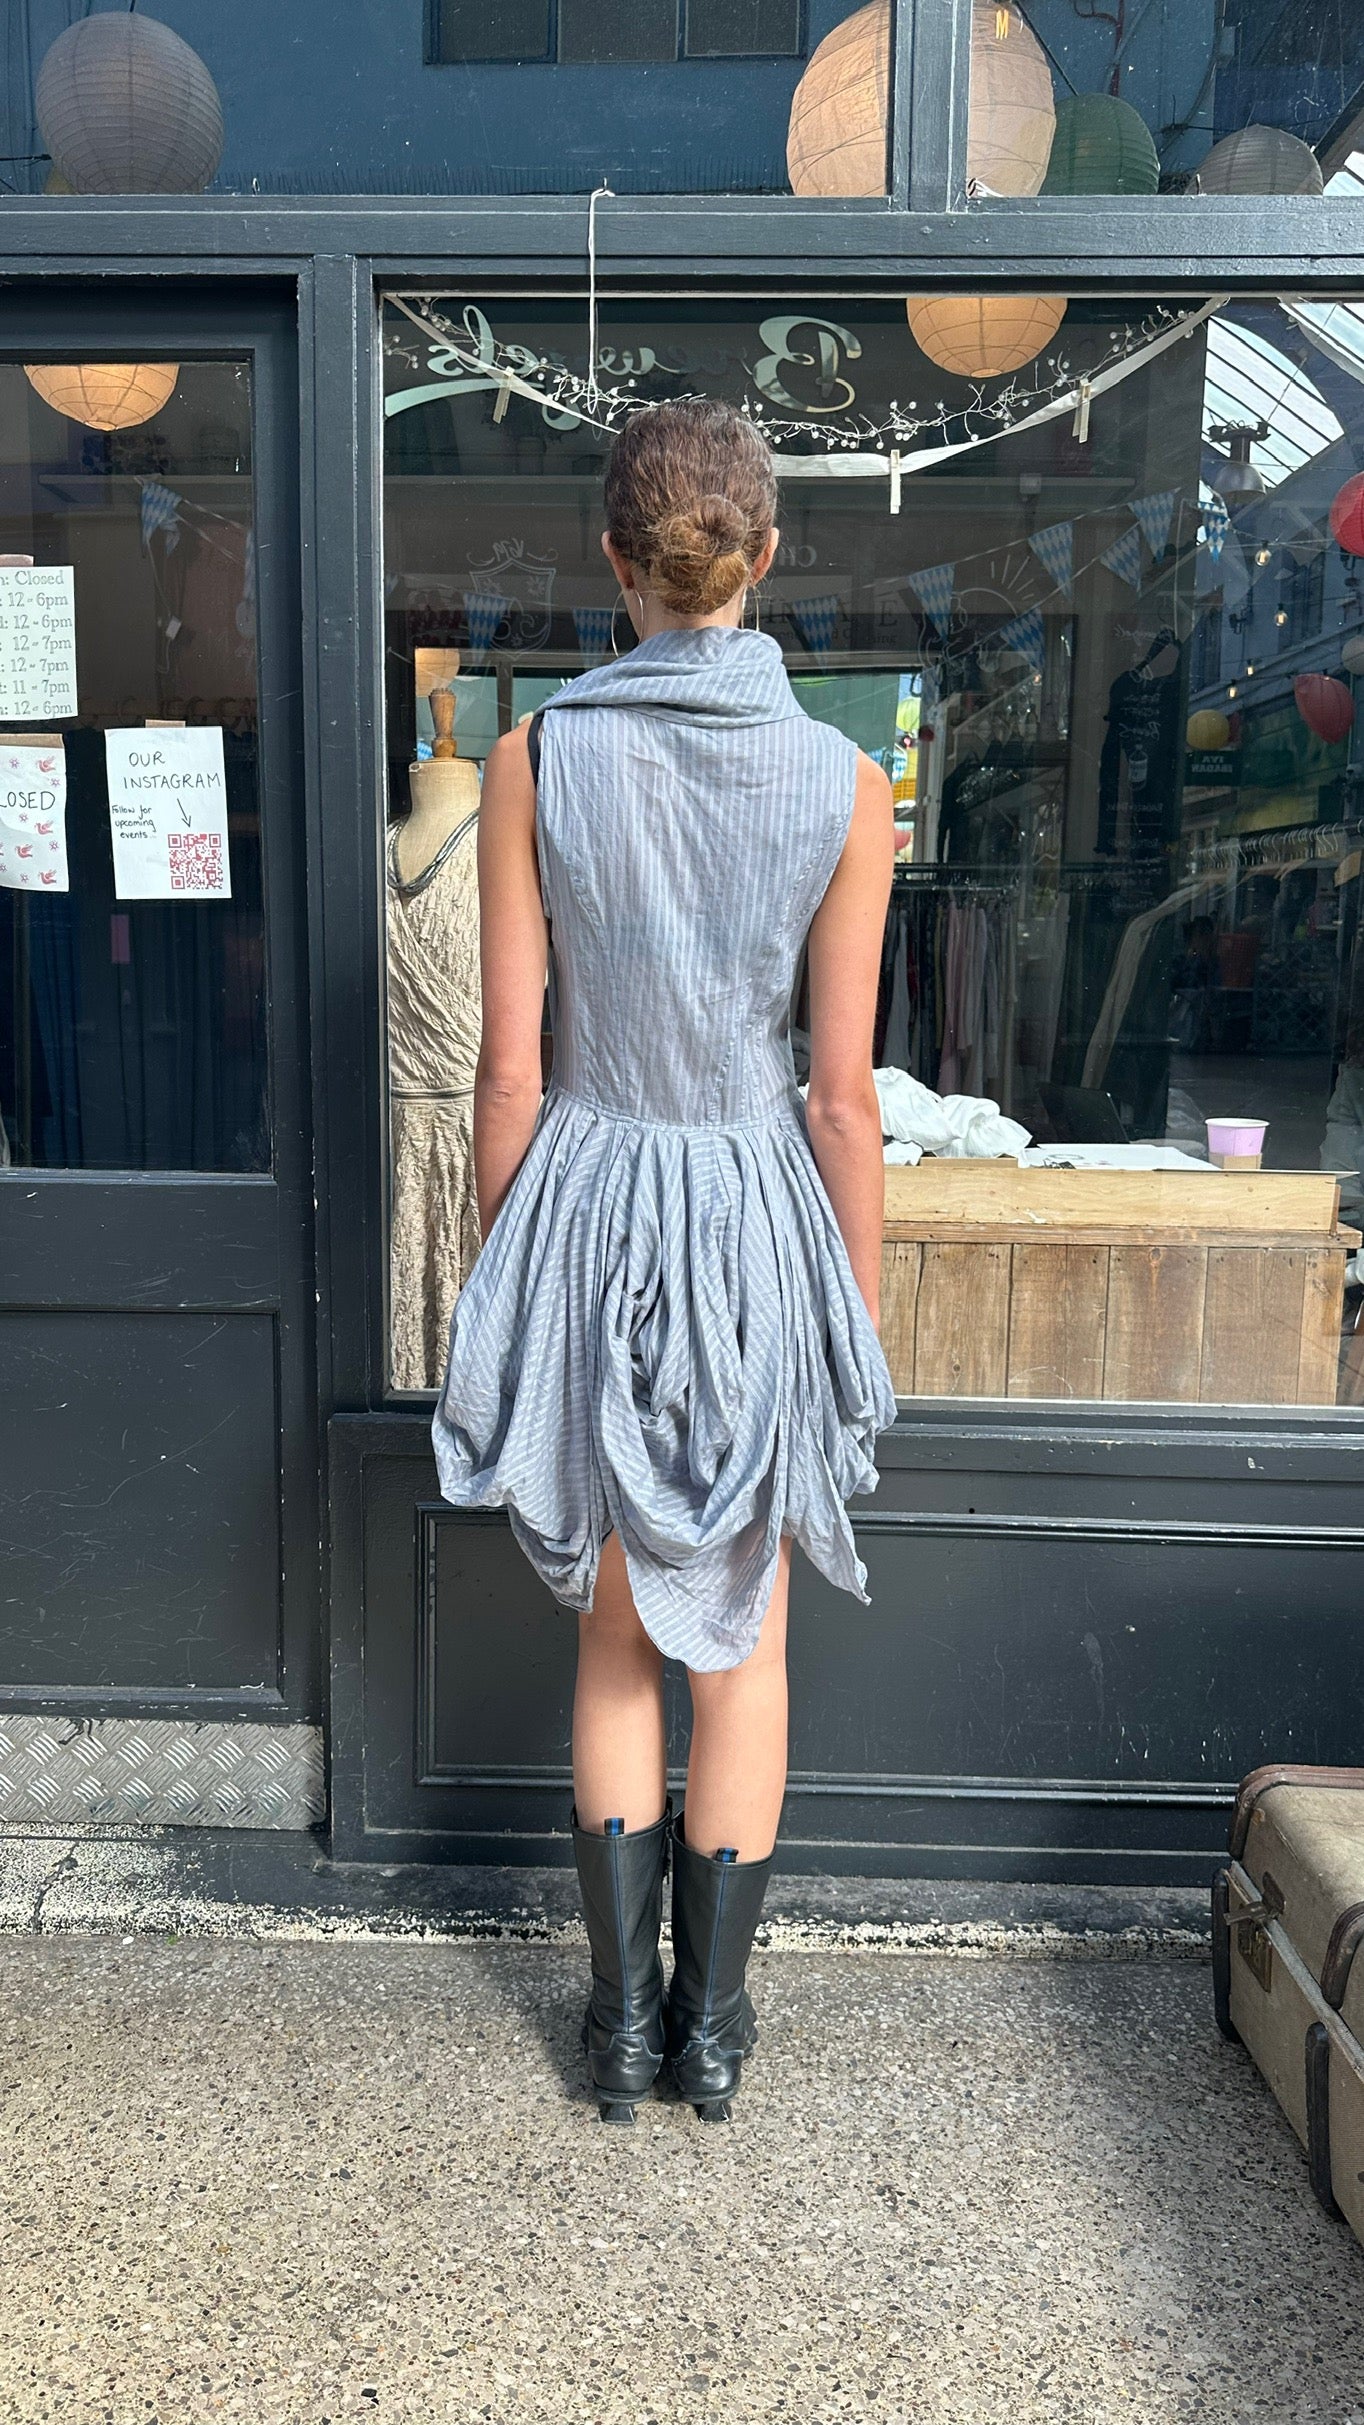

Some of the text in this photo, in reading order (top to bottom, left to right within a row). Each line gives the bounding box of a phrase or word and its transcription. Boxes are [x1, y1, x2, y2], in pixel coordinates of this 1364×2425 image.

[14, 570, 65, 585] Closed
[8, 592, 25, 607] 12
[36, 592, 69, 610] 6pm
[13, 614, 30, 629] 12
[41, 614, 73, 632] 6pm
[13, 635, 30, 651] 12
[42, 635, 72, 654] 7pm
[10, 657, 27, 672] 12
[39, 658, 69, 675] 7pm
[13, 680, 27, 694] 11
[42, 679, 70, 697] 7pm
[14, 700, 31, 715] 12
[43, 701, 73, 718] 6pm
[128, 751, 166, 767] OUR
[123, 772, 221, 789] INSTAGRAM
[0, 791, 56, 810] OSED
[111, 804, 152, 820] Follow for
[114, 819, 157, 833] upcoming
